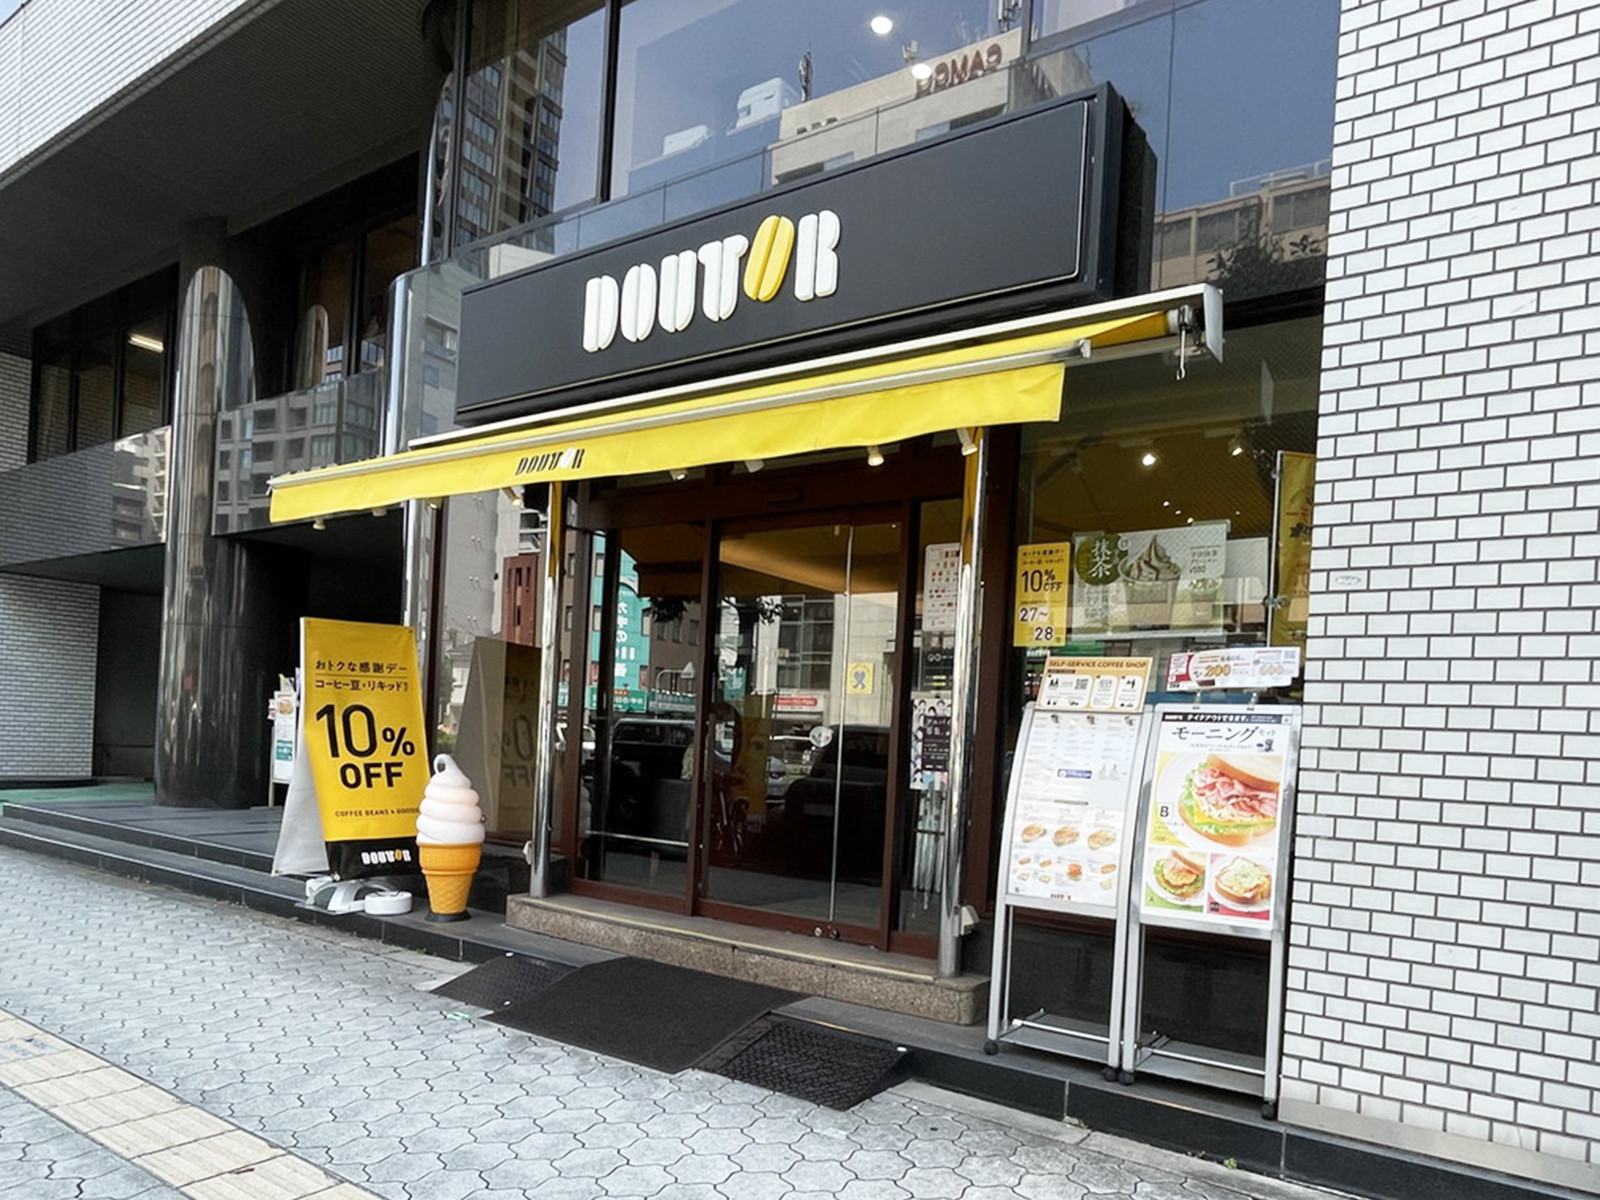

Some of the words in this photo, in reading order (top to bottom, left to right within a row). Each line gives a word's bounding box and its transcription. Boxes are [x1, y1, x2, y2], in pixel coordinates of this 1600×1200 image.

[583, 210, 841, 353] DOUTOR
[515, 448, 585, 475] DOUTOR
[1035, 626, 1053, 641] 28
[316, 660, 408, 674] おトクな感謝デー
[1097, 661, 1124, 669] COFFEE
[1125, 661, 1147, 669] SHOP
[315, 704, 416, 759] 10%
[1172, 726, 1259, 744] モーニング
[339, 762, 404, 790] OFF
[334, 810, 362, 818] COFFEE
[361, 849, 411, 865] DOUTOR
